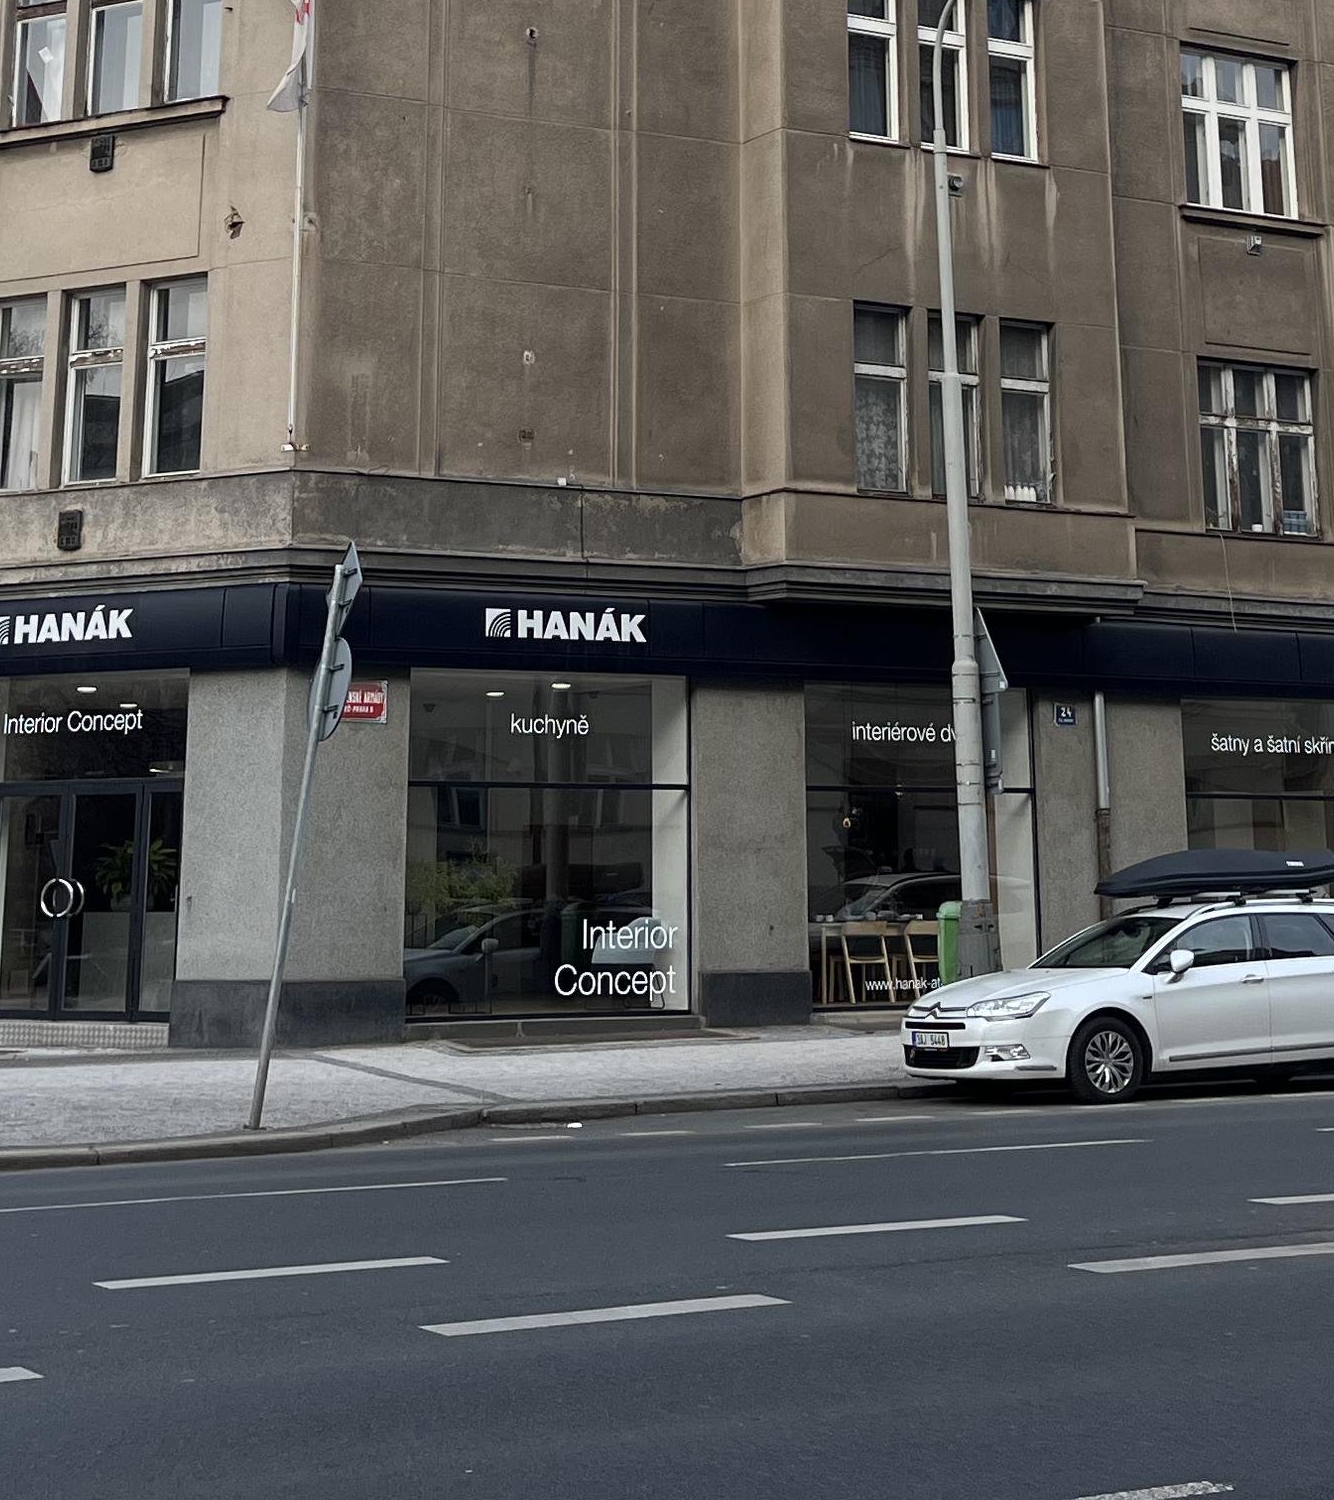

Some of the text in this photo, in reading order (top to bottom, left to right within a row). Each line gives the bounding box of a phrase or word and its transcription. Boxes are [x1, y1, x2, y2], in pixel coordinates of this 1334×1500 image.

[13, 604, 134, 645] HANÁK
[517, 607, 647, 643] HANÁK
[3, 709, 144, 735] Interior Concept
[510, 713, 590, 739] kuchyně
[852, 720, 936, 743] interiérové
[1210, 732, 1250, 757] šatny
[1253, 738, 1264, 752] a
[1266, 734, 1301, 754] šatní
[582, 918, 679, 950] Interior
[554, 963, 677, 1002] Concept
